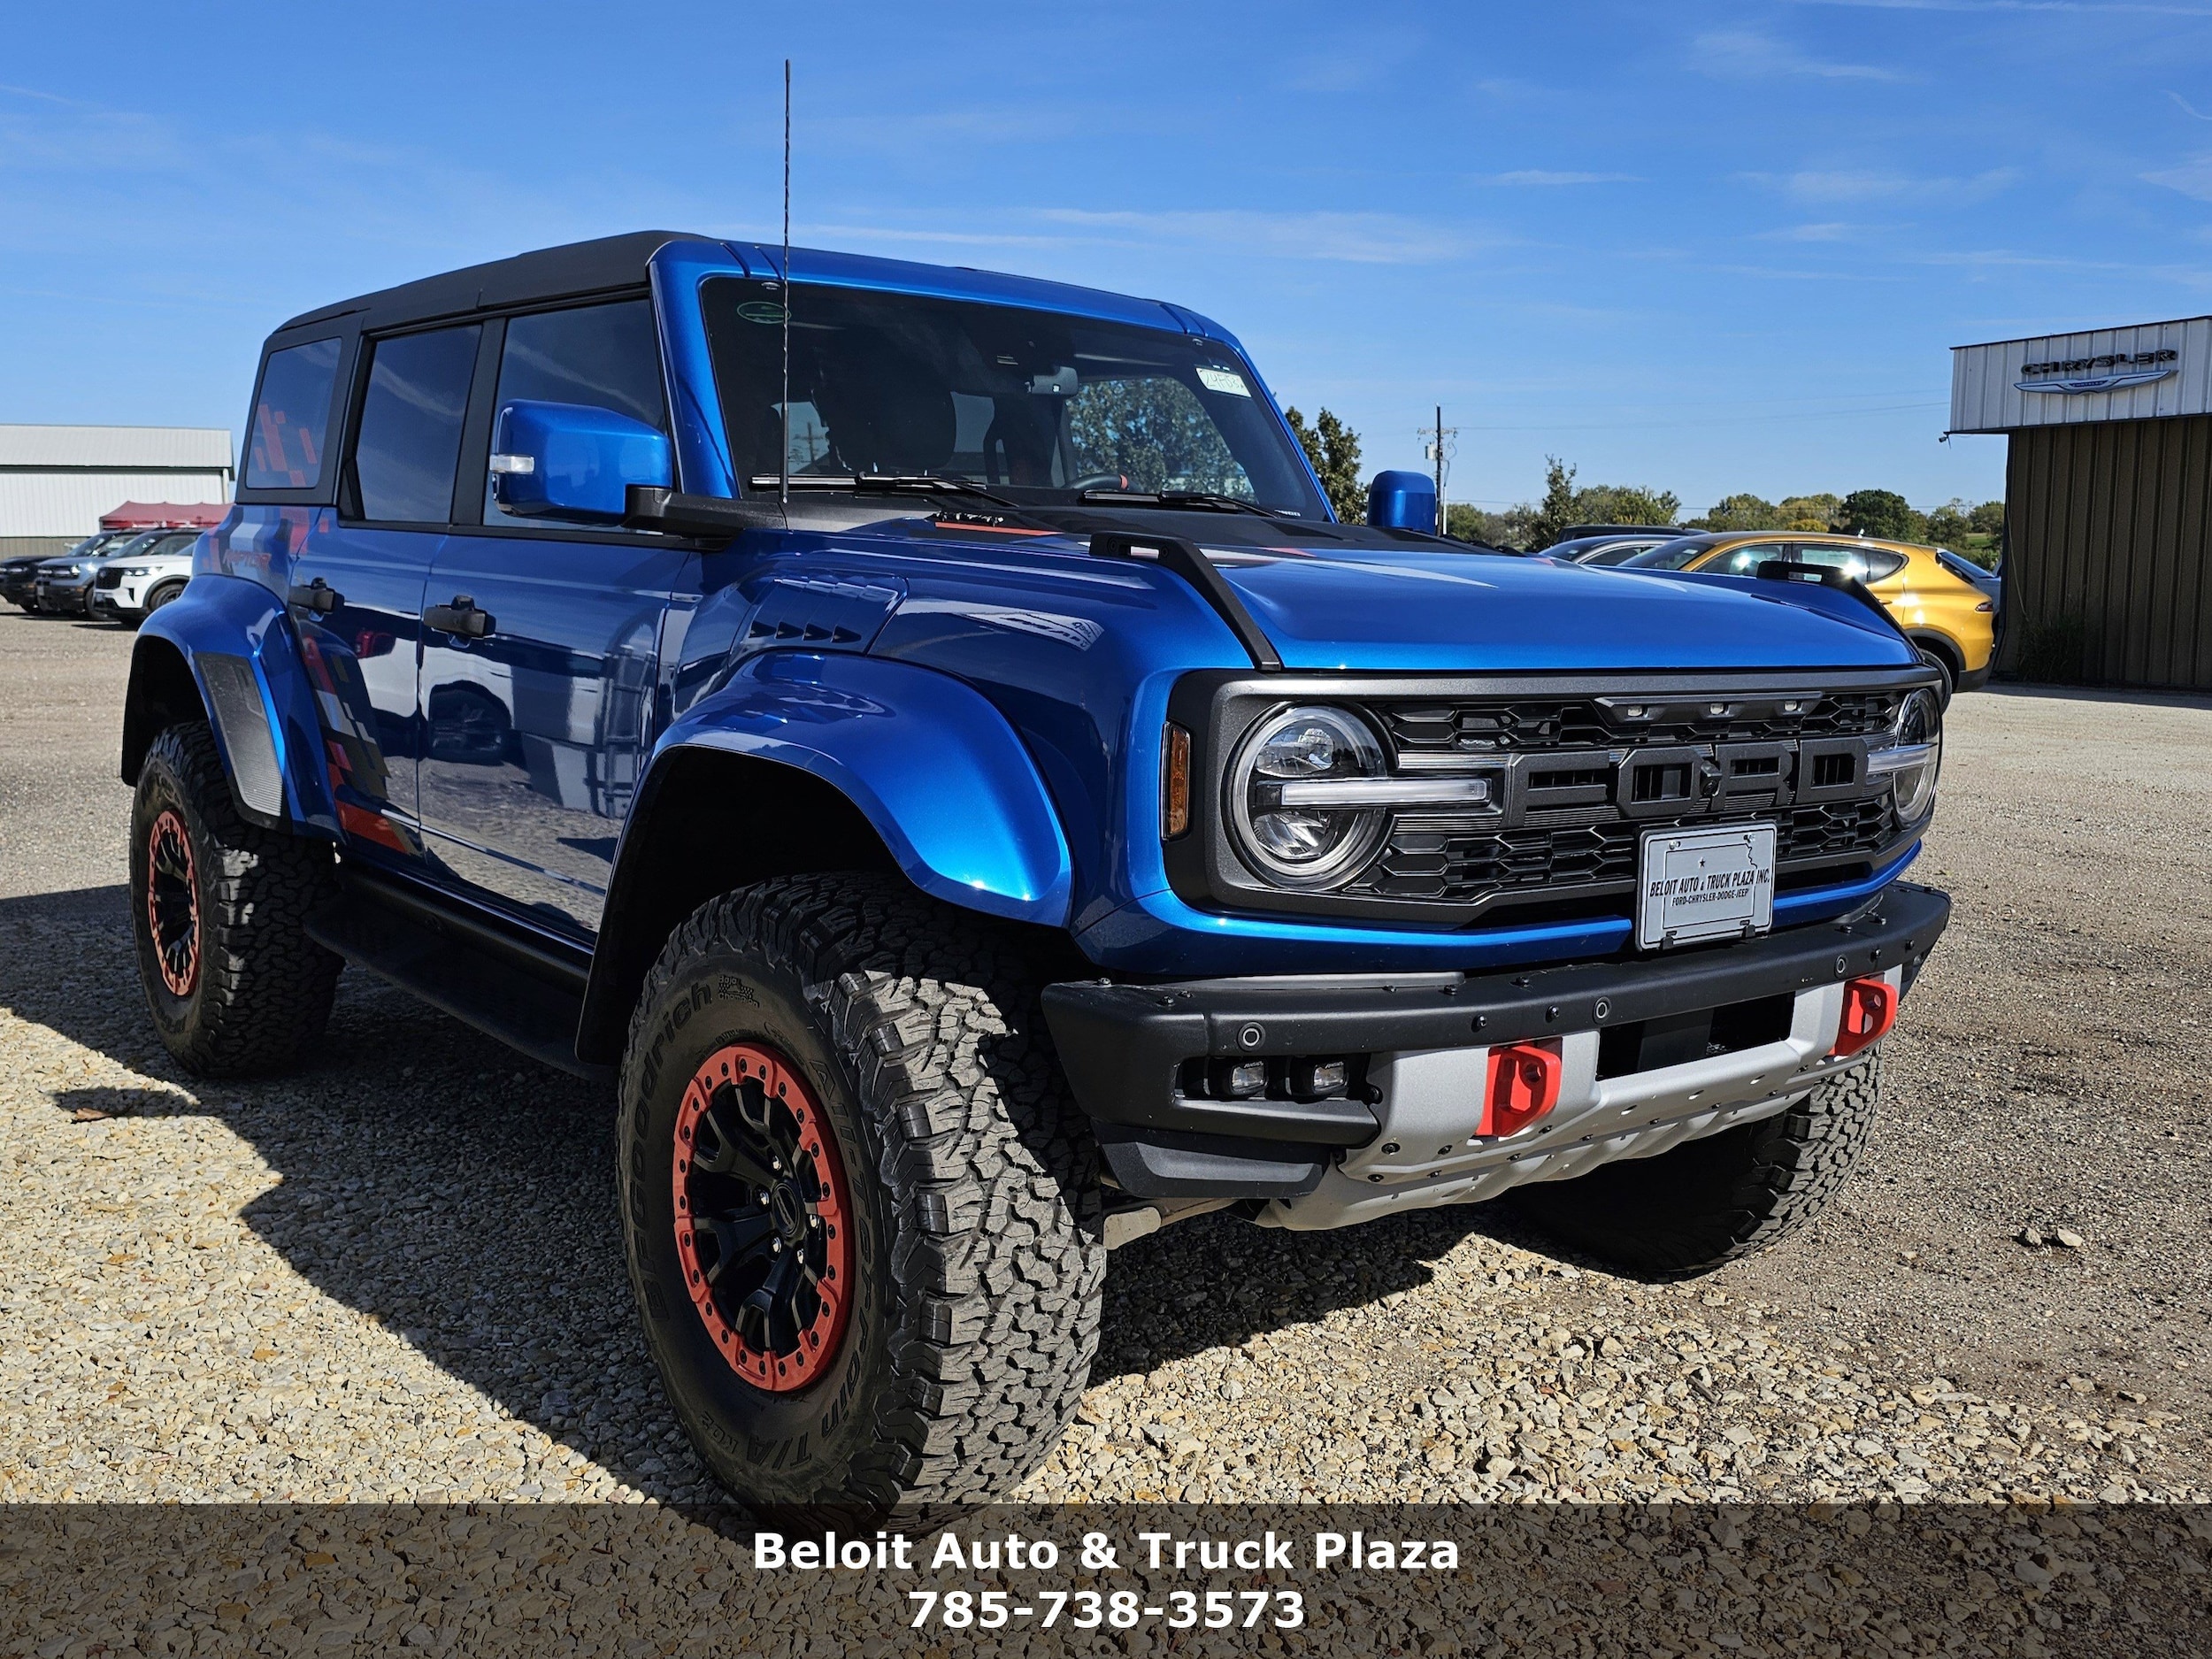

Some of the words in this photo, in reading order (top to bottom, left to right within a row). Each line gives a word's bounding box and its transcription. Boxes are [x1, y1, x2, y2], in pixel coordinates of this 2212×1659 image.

[2021, 349, 2178, 375] CHRYSLER
[1510, 736, 1869, 830] FORD
[1649, 879, 1678, 898] BELOIT
[1678, 877, 1699, 894] AUTO
[1700, 879, 1705, 890] &
[1707, 872, 1731, 890] TRUCK
[1732, 870, 1755, 887] PLAZA
[1755, 868, 1770, 884] INC.
